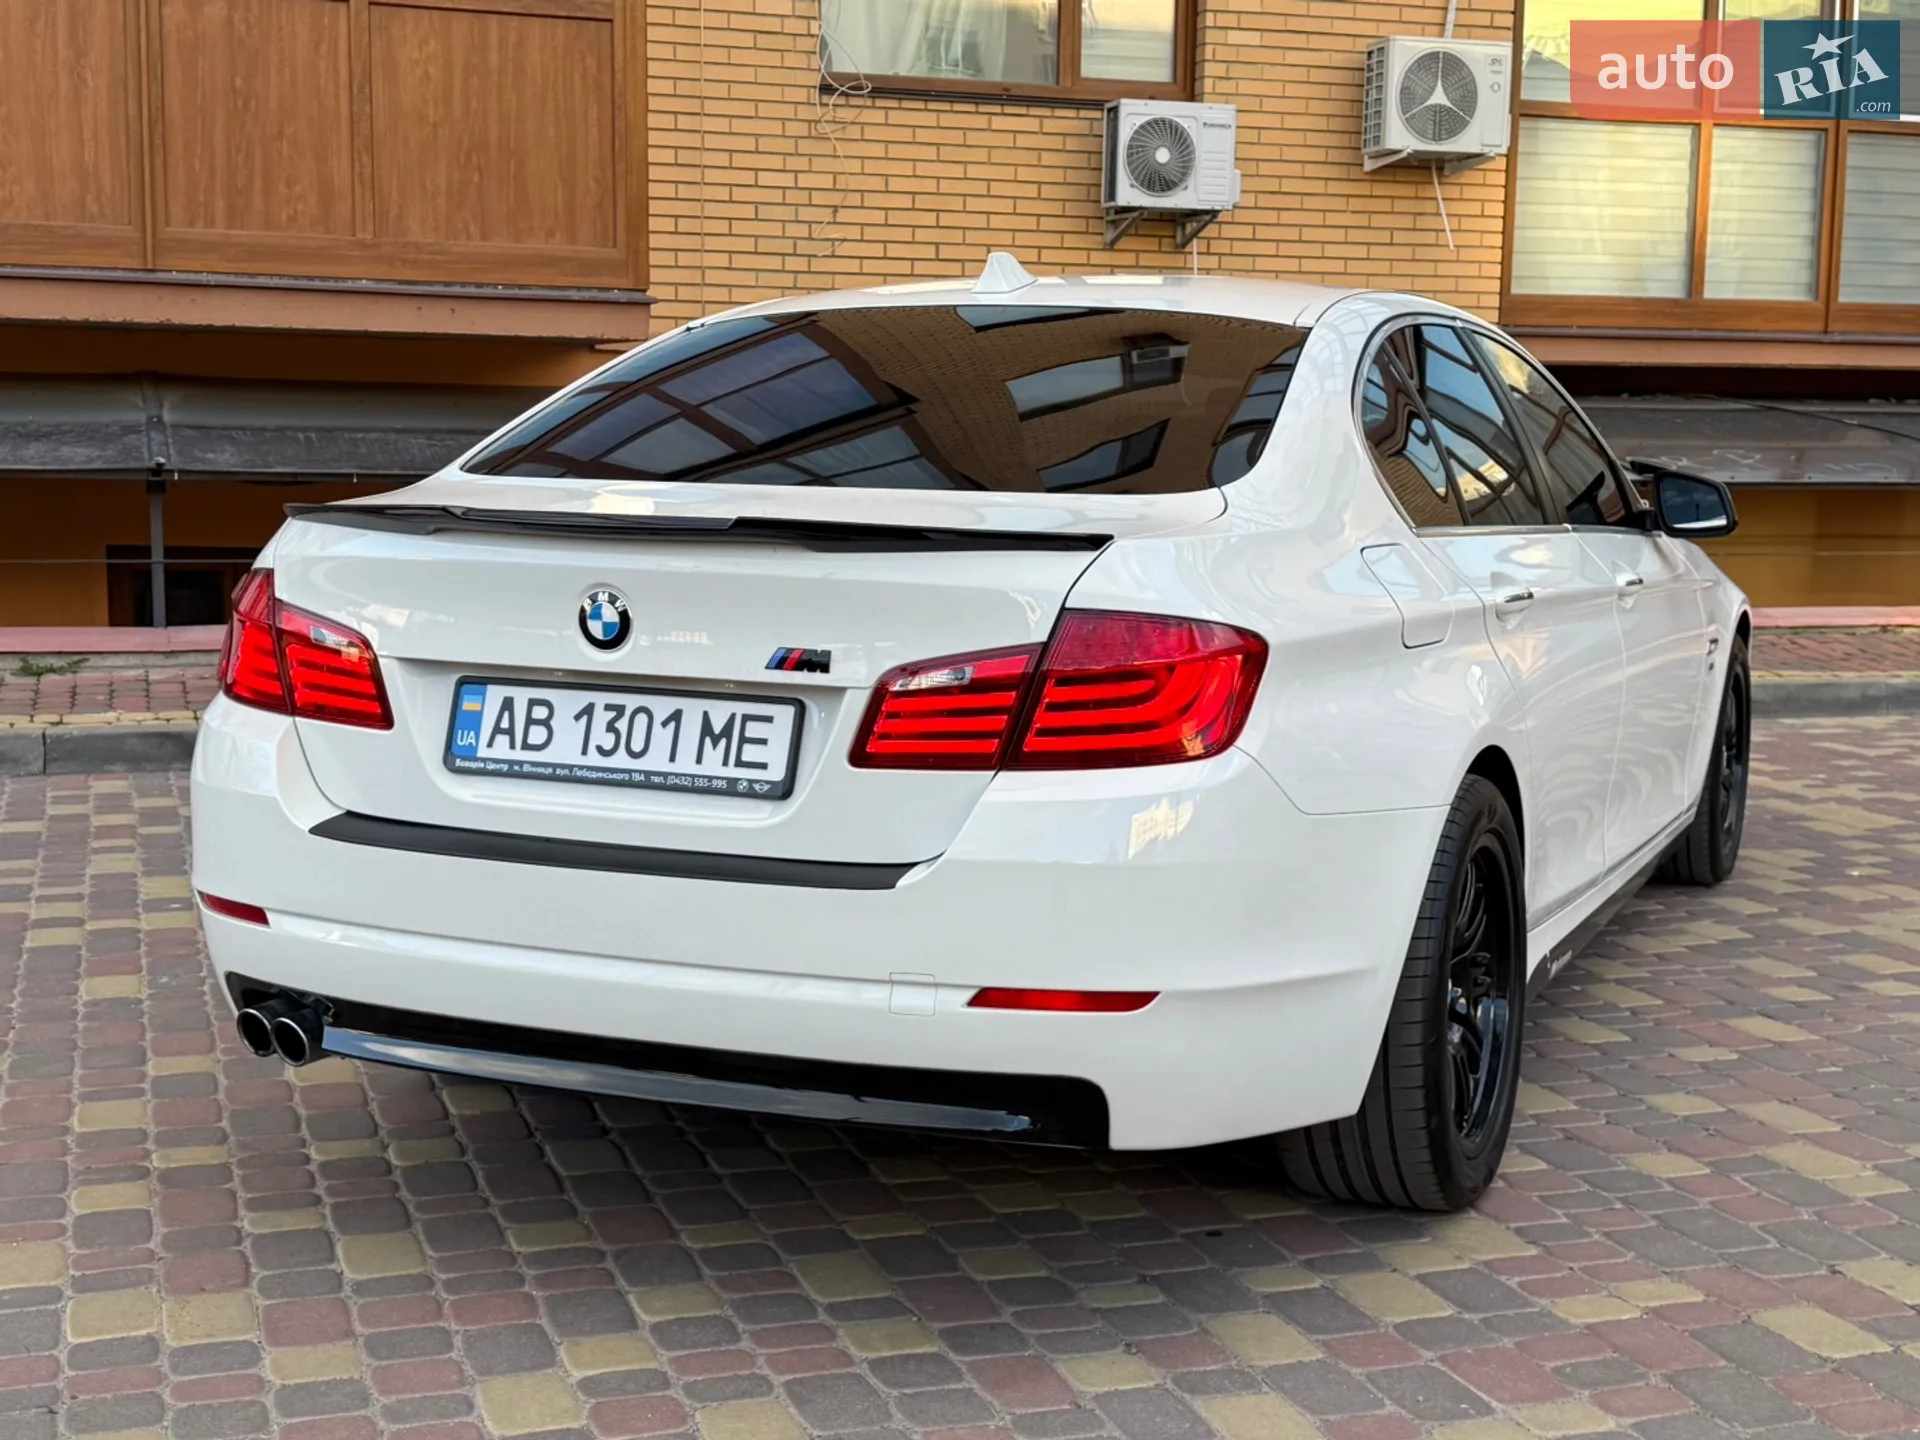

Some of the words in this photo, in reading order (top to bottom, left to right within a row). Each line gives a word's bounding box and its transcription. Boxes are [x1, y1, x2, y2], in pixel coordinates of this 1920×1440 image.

[582, 591, 627, 612] BMW
[457, 730, 476, 747] UA
[486, 696, 555, 752] AB
[573, 702, 684, 763] 1301
[695, 710, 775, 770] ME
[694, 778, 727, 789] 555-995
